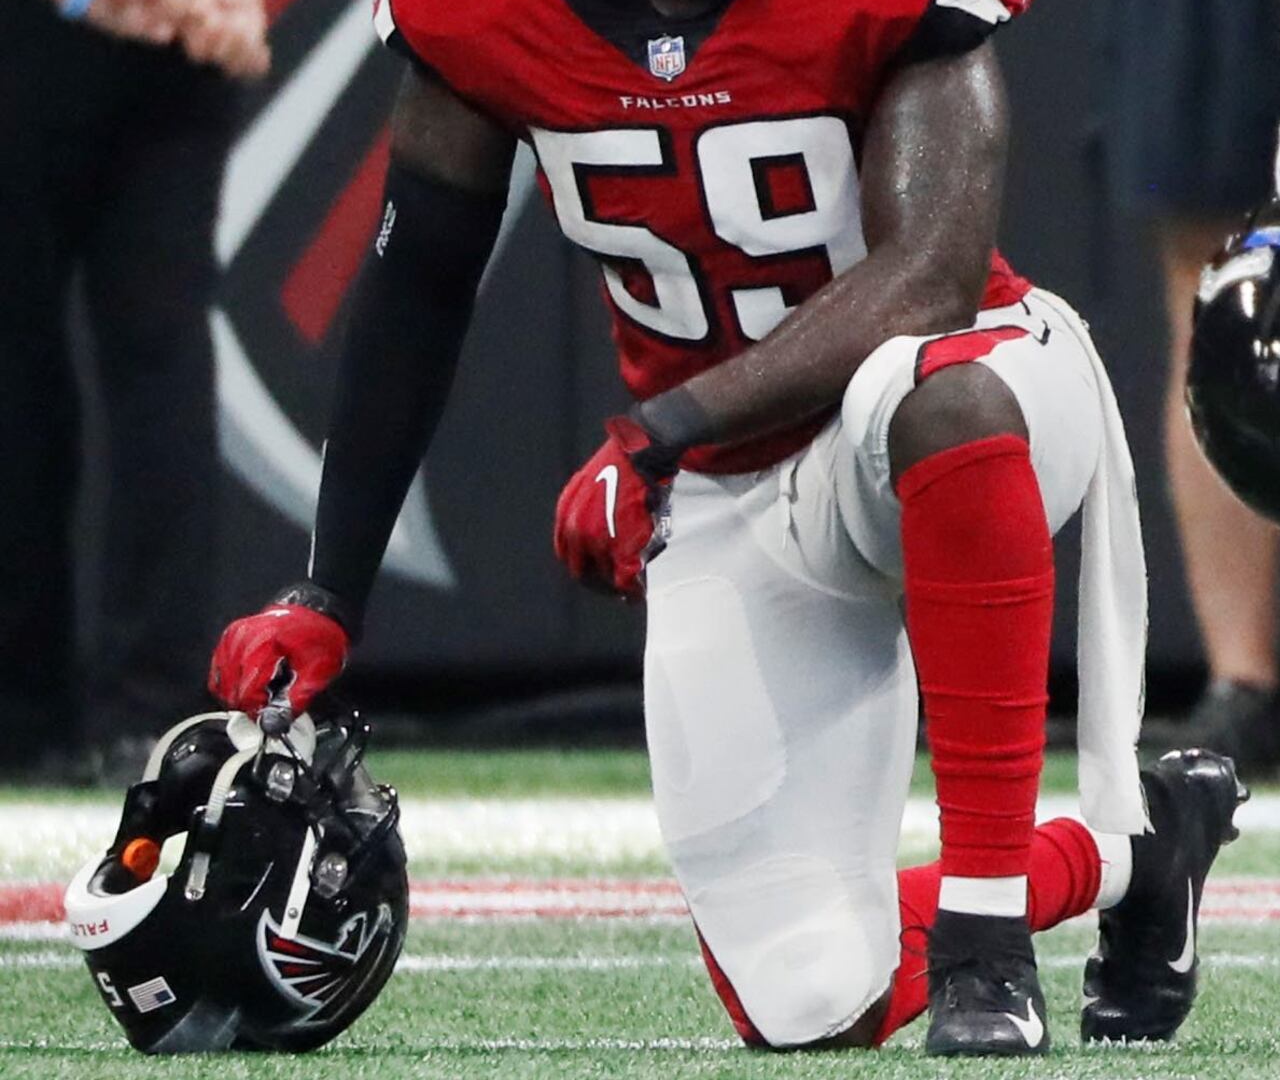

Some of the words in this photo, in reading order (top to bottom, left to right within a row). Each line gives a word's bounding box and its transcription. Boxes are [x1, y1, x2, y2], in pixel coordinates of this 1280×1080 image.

[655, 53, 679, 71] NFL
[620, 91, 732, 109] FALCONS
[528, 116, 869, 341] 59
